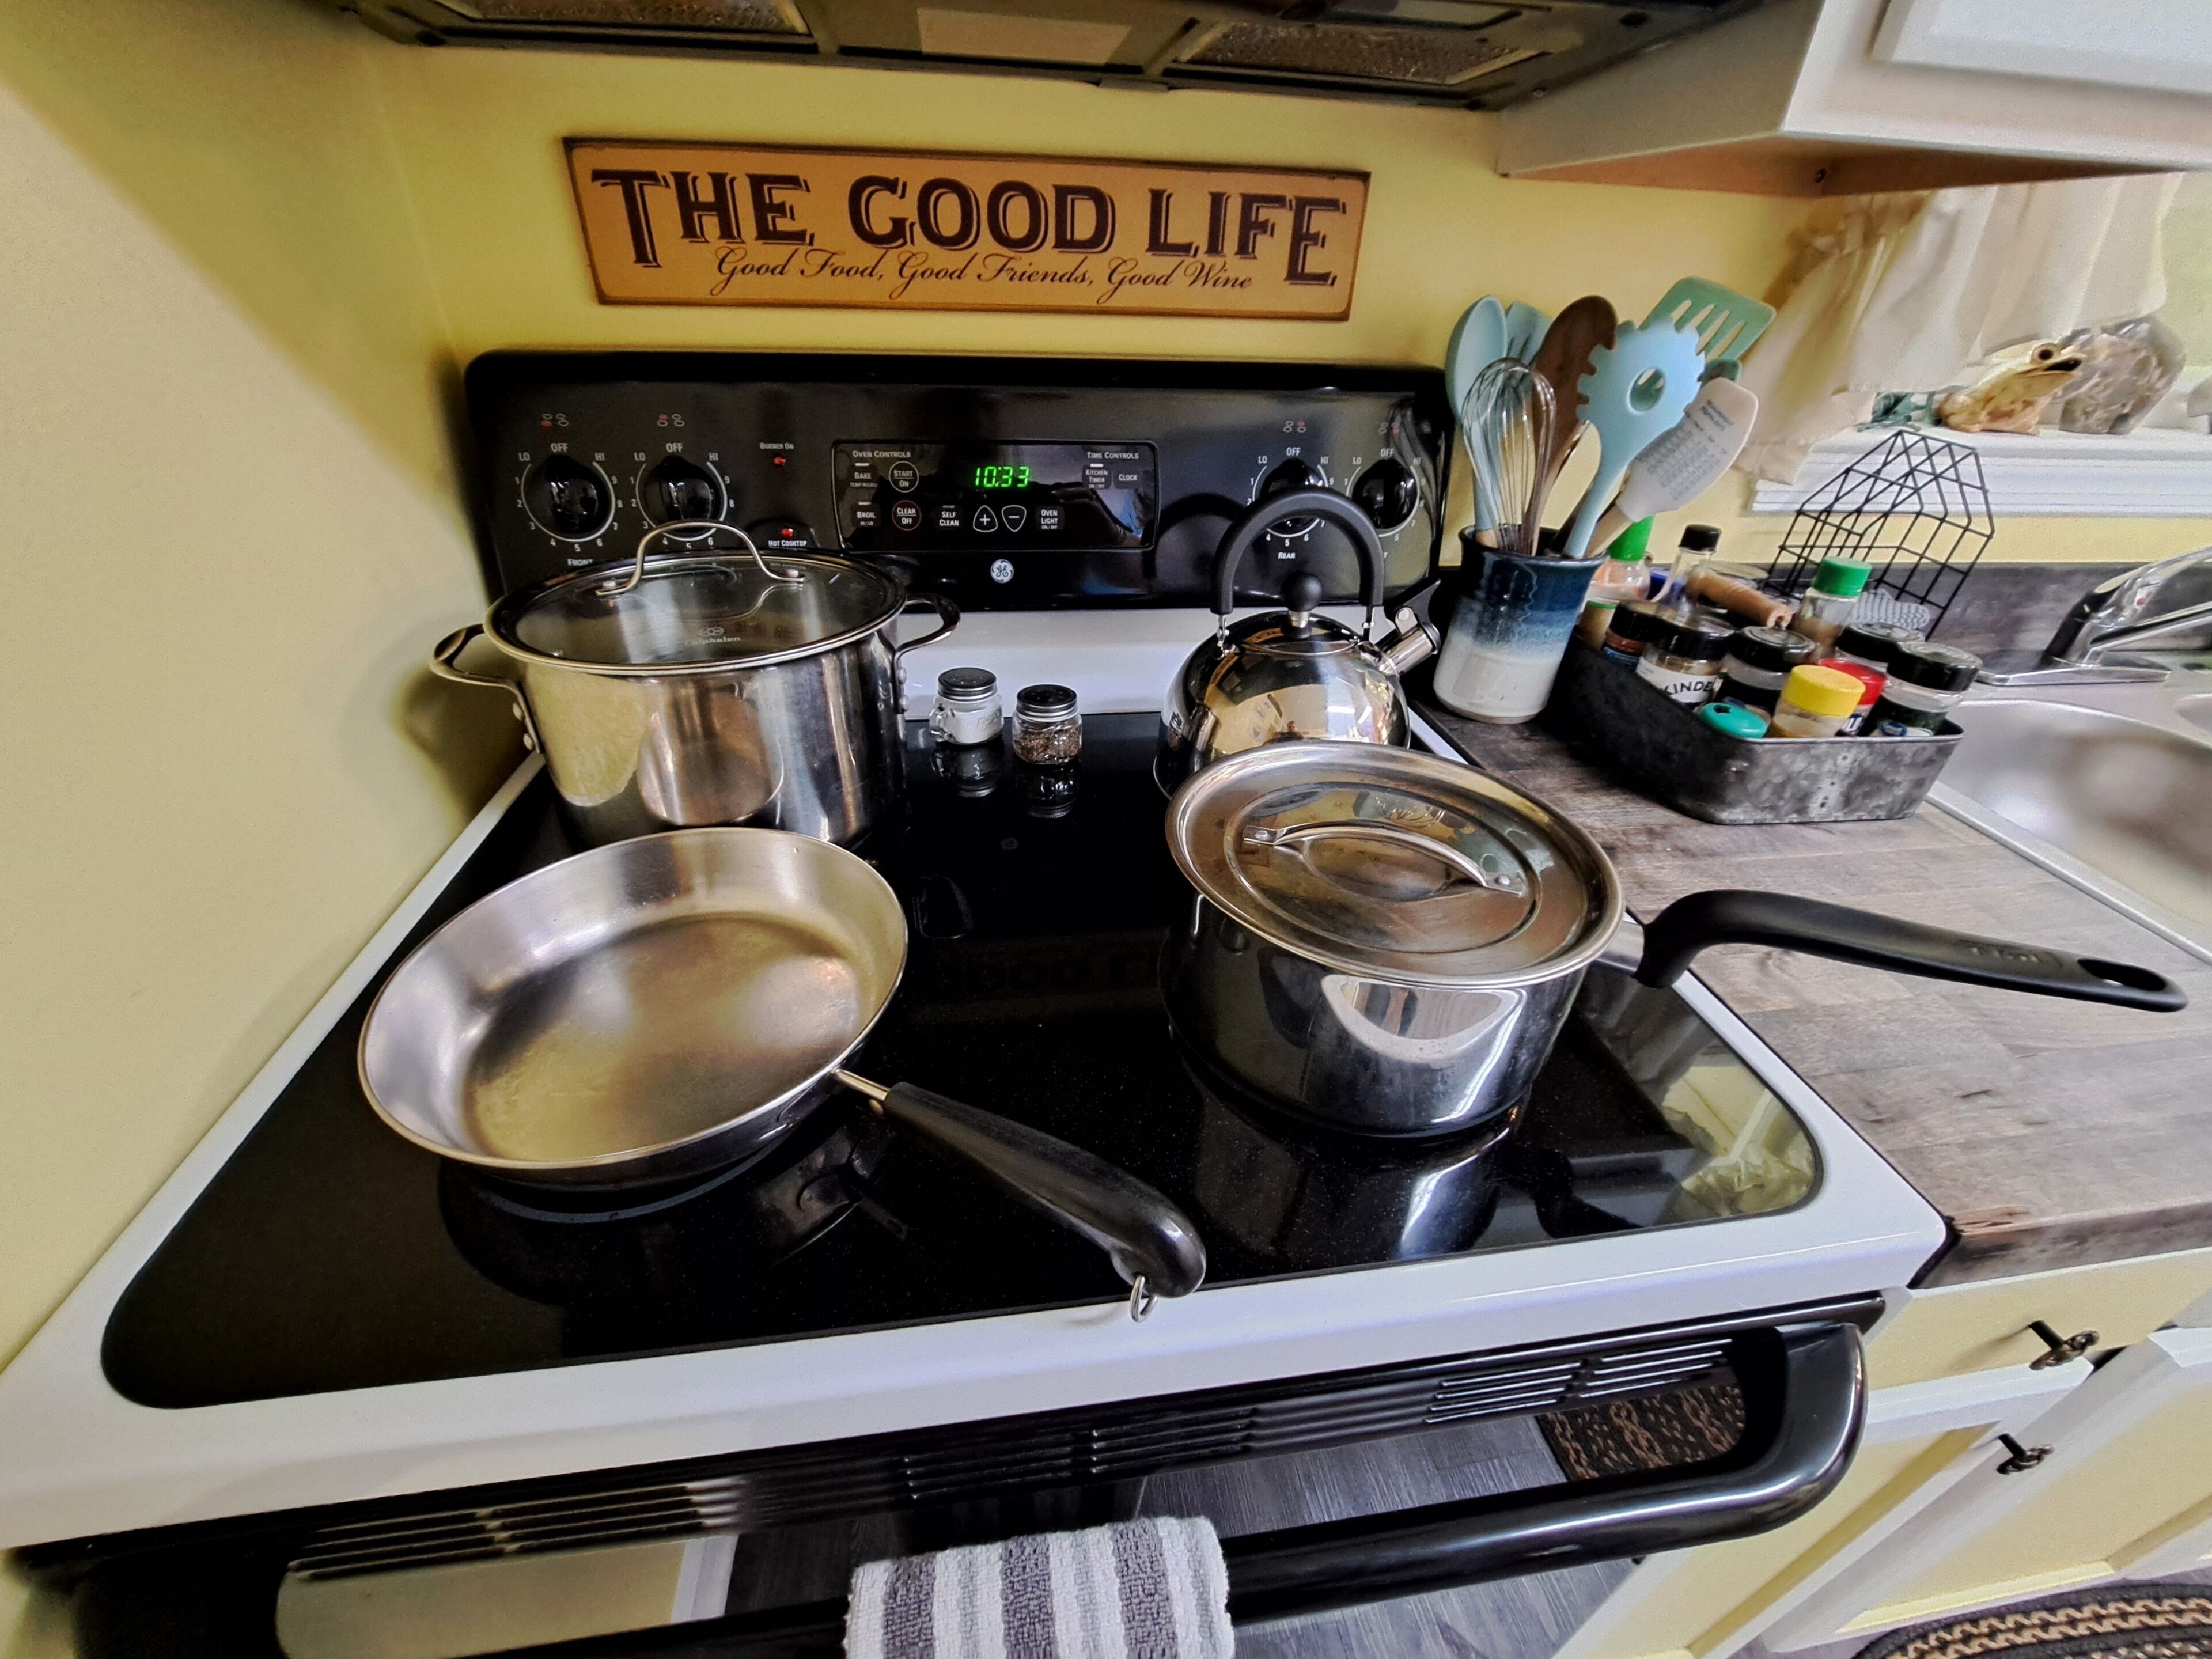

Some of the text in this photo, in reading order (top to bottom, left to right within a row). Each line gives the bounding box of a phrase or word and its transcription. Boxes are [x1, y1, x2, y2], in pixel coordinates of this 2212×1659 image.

[591, 169, 1347, 287] THE GOOD LIFE
[709, 245, 1253, 304] Good Food, Good Friends, Good Wine
[551, 442, 568, 452] OFF
[666, 442, 683, 452] OFF
[759, 442, 794, 450] BURNER ON
[1286, 447, 1301, 456] OFF
[1380, 448, 1394, 457] OFF
[518, 452, 531, 461] LO
[594, 452, 605, 461] HI
[634, 452, 646, 461] LO
[709, 452, 718, 461] HI
[1257, 456, 1267, 464] LO
[1320, 456, 1329, 464] HI
[1353, 456, 1362, 464] LO
[515, 476, 519, 485] 1
[611, 476, 618, 484] 9
[724, 476, 730, 484] 9
[975, 466, 1029, 487] 10:33
[1250, 477, 1254, 485] 1
[1329, 477, 1334, 485] 9
[517, 499, 522, 508] 2
[616, 499, 623, 508] 8
[631, 499, 637, 507] 2
[729, 499, 735, 508] 8
[530, 522, 535, 530] 3
[612, 522, 618, 531] 7
[643, 521, 649, 529] 3
[662, 537, 668, 546] 4
[707, 537, 714, 546] 6
[1266, 533, 1271, 541] 4
[1304, 533, 1309, 541] 6
[1394, 533, 1399, 541] 6
[550, 538, 556, 547] 4
[597, 538, 603, 547] 6
[1285, 539, 1290, 547] 5
[575, 543, 581, 552] 5
[1278, 551, 1296, 559] REAR
